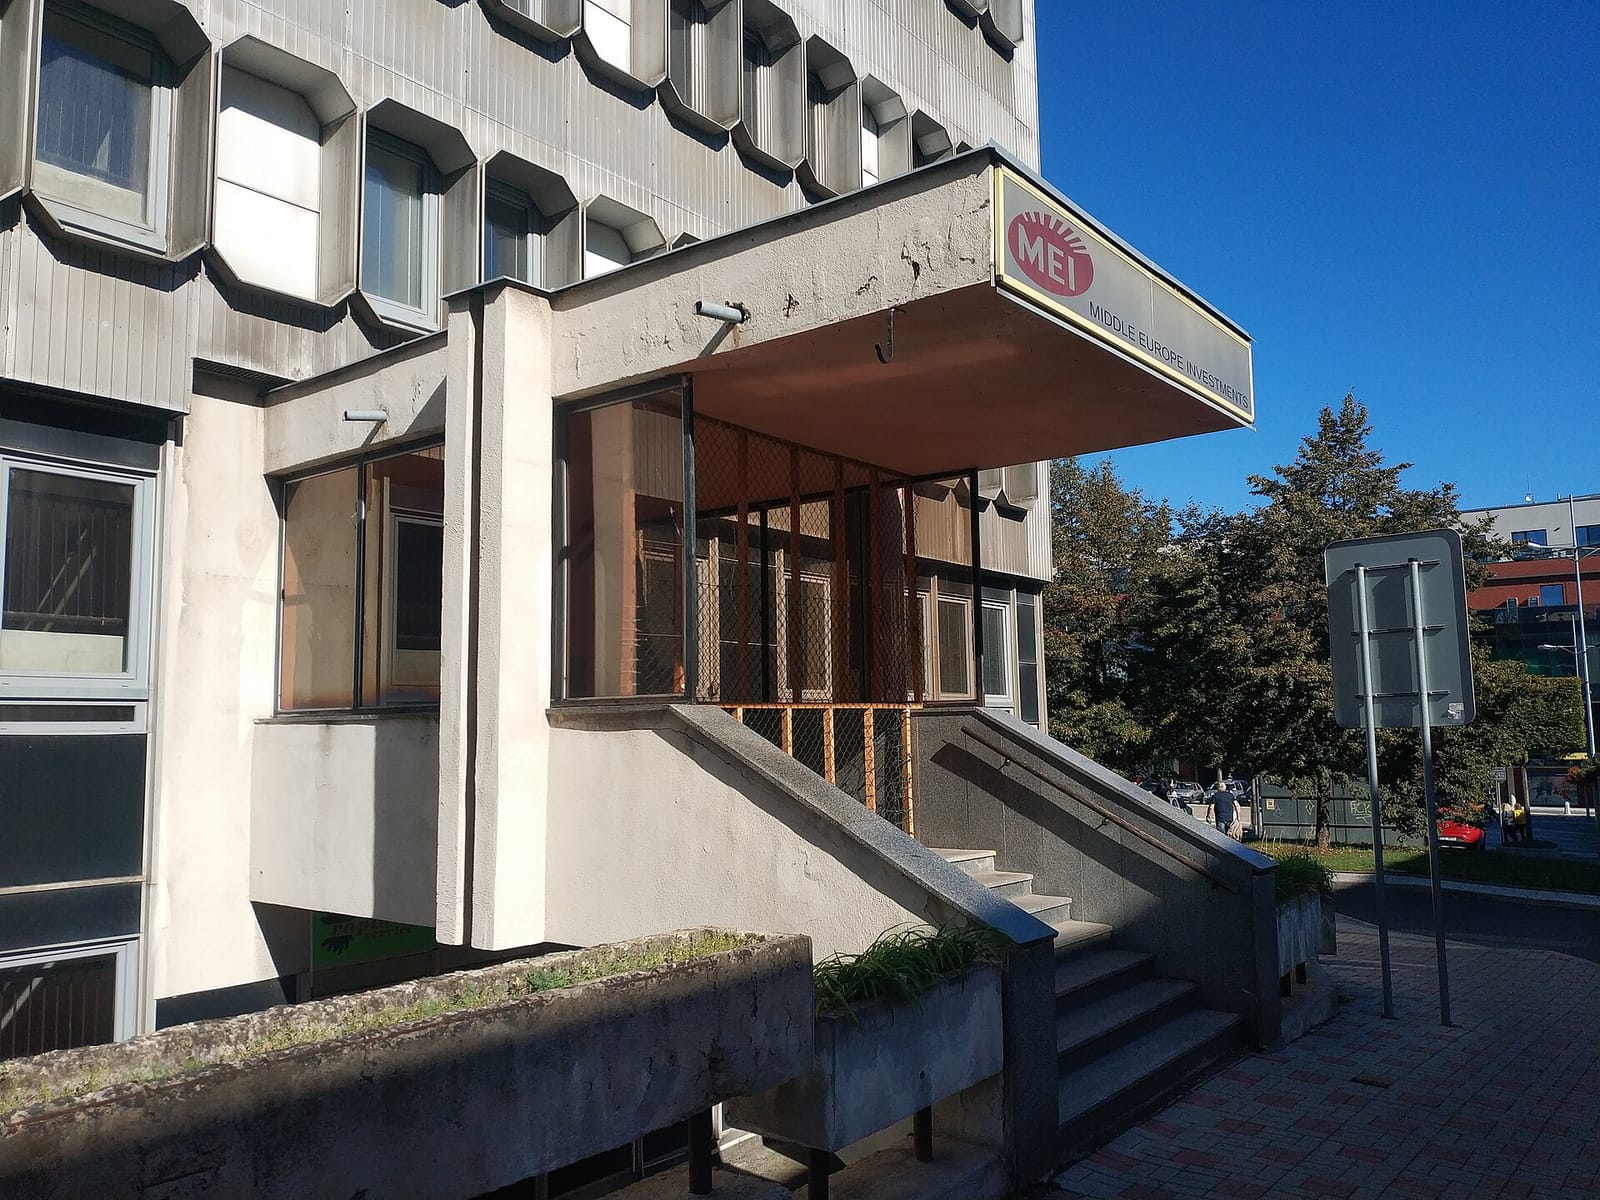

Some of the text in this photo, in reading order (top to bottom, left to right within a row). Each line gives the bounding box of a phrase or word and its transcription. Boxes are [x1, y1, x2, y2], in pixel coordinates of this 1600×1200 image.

[1018, 223, 1075, 292] MEI
[1089, 301, 1249, 409] MIDDLE EUROPE INVESTMENTS
